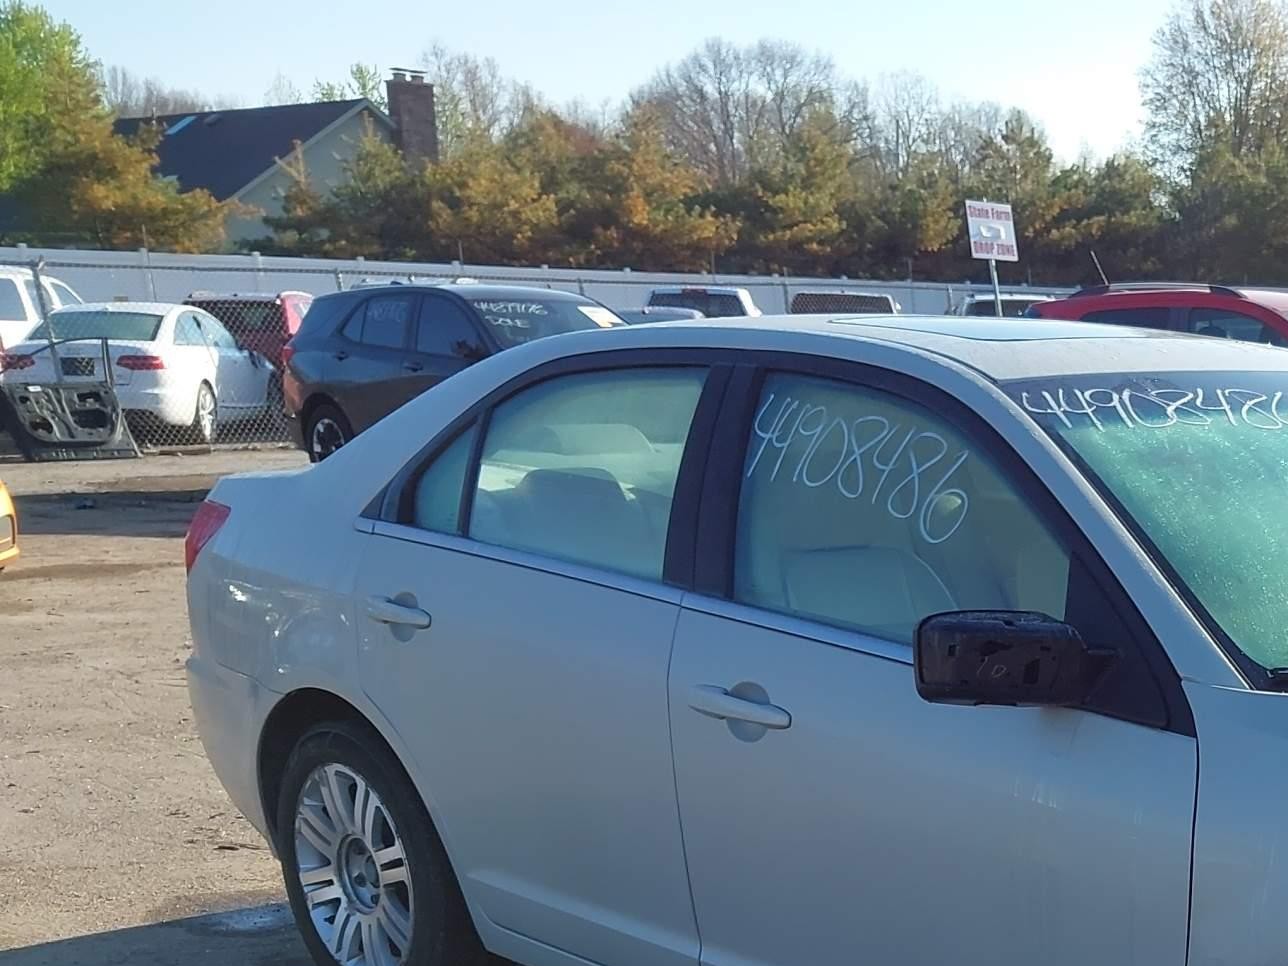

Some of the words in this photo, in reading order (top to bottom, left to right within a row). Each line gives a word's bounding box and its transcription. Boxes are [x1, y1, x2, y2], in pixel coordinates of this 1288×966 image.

[968, 205, 990, 219] State
[991, 208, 1011, 222] Farm
[747, 393, 969, 544] 44908486
